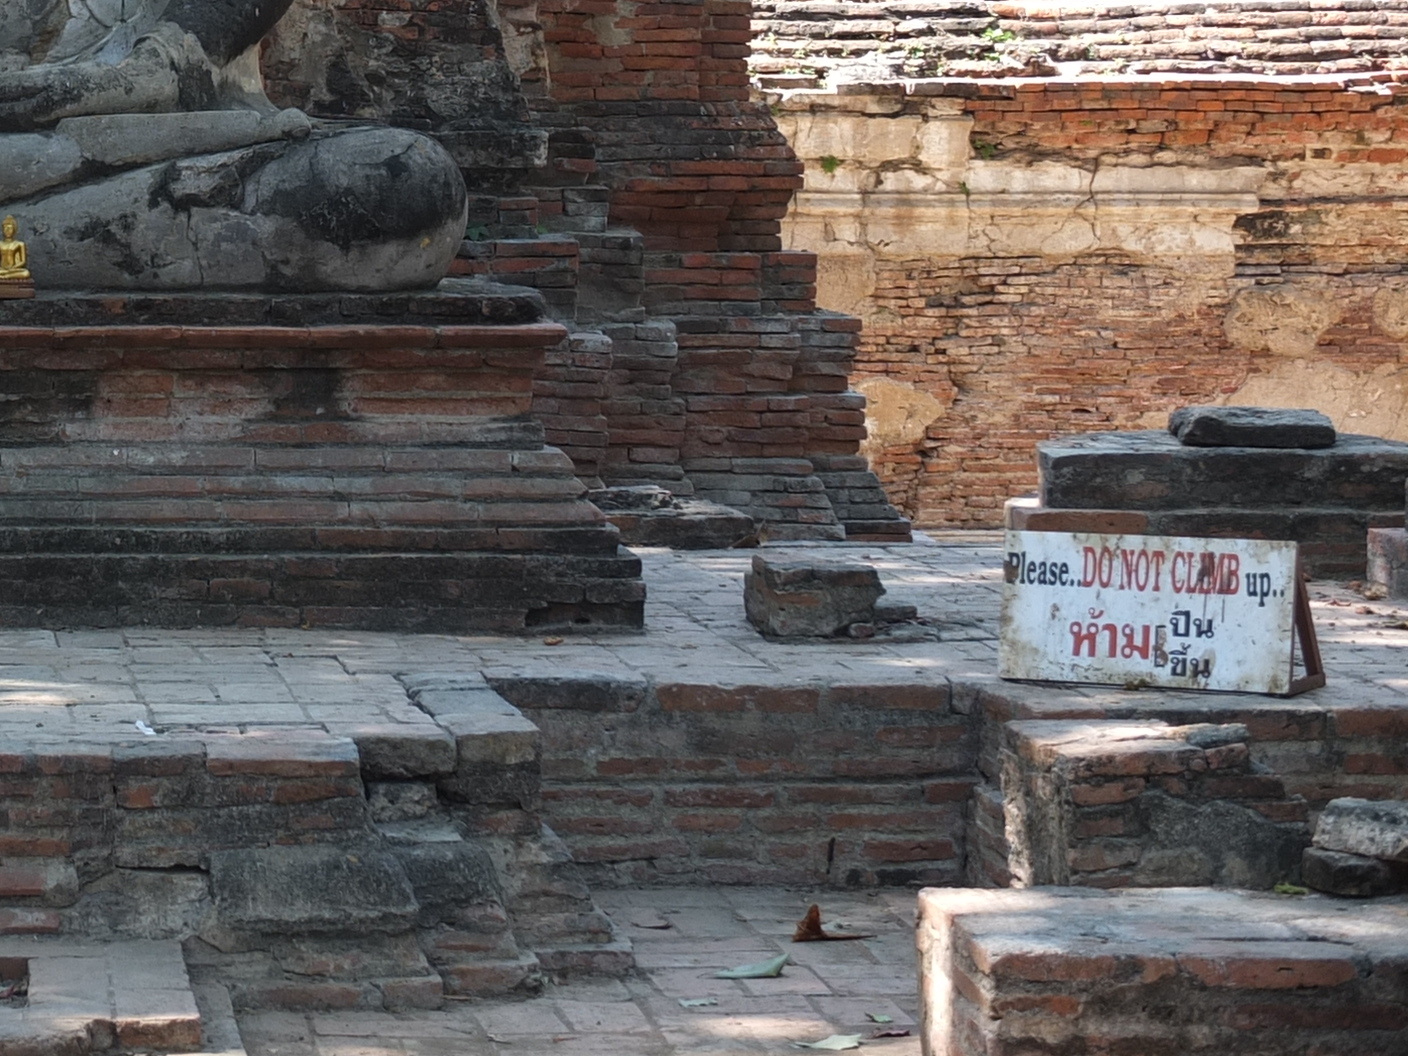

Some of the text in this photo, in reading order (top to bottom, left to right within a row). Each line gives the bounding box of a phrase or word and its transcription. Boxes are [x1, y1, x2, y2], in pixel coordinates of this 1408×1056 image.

[1081, 546, 1113, 589] DO
[1119, 549, 1165, 593] NOT
[1171, 550, 1240, 595] CLIMB
[1069, 607, 1150, 660] ห้าม
